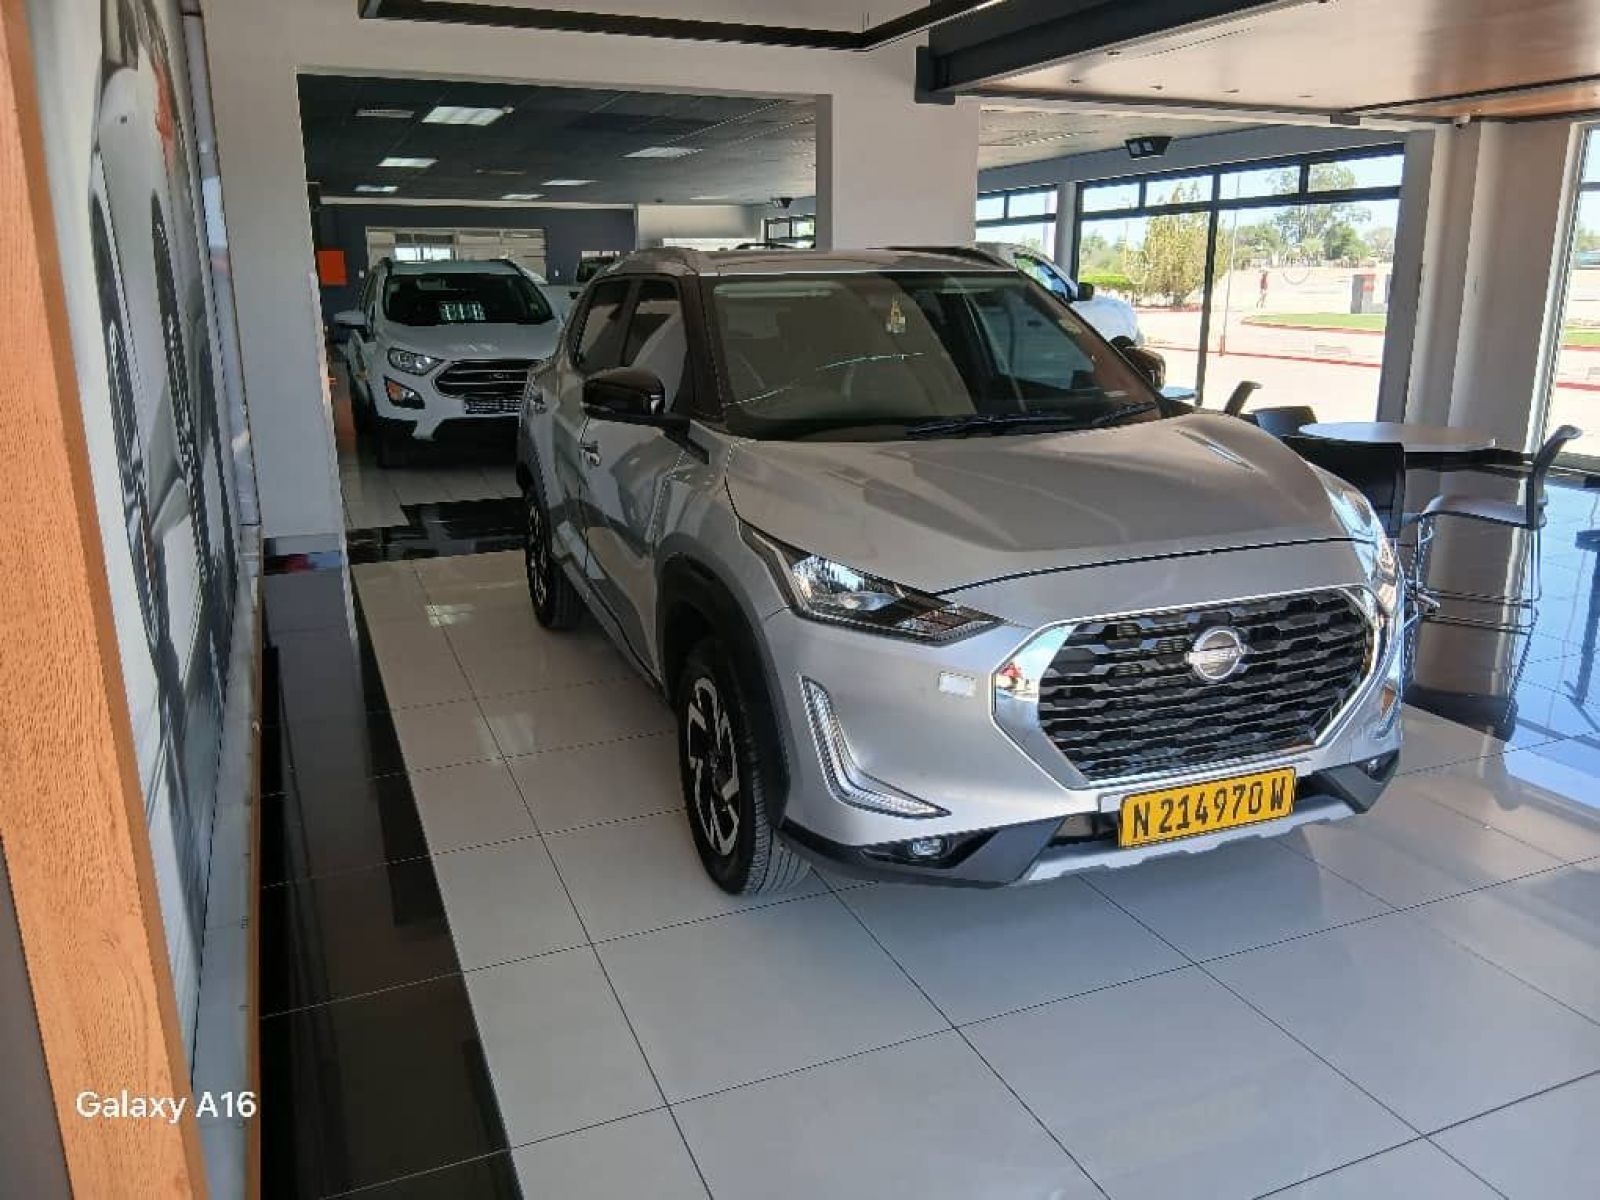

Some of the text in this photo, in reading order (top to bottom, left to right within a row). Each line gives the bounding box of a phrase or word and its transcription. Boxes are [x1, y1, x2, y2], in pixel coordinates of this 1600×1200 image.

[1133, 776, 1287, 839] N 214970 W
